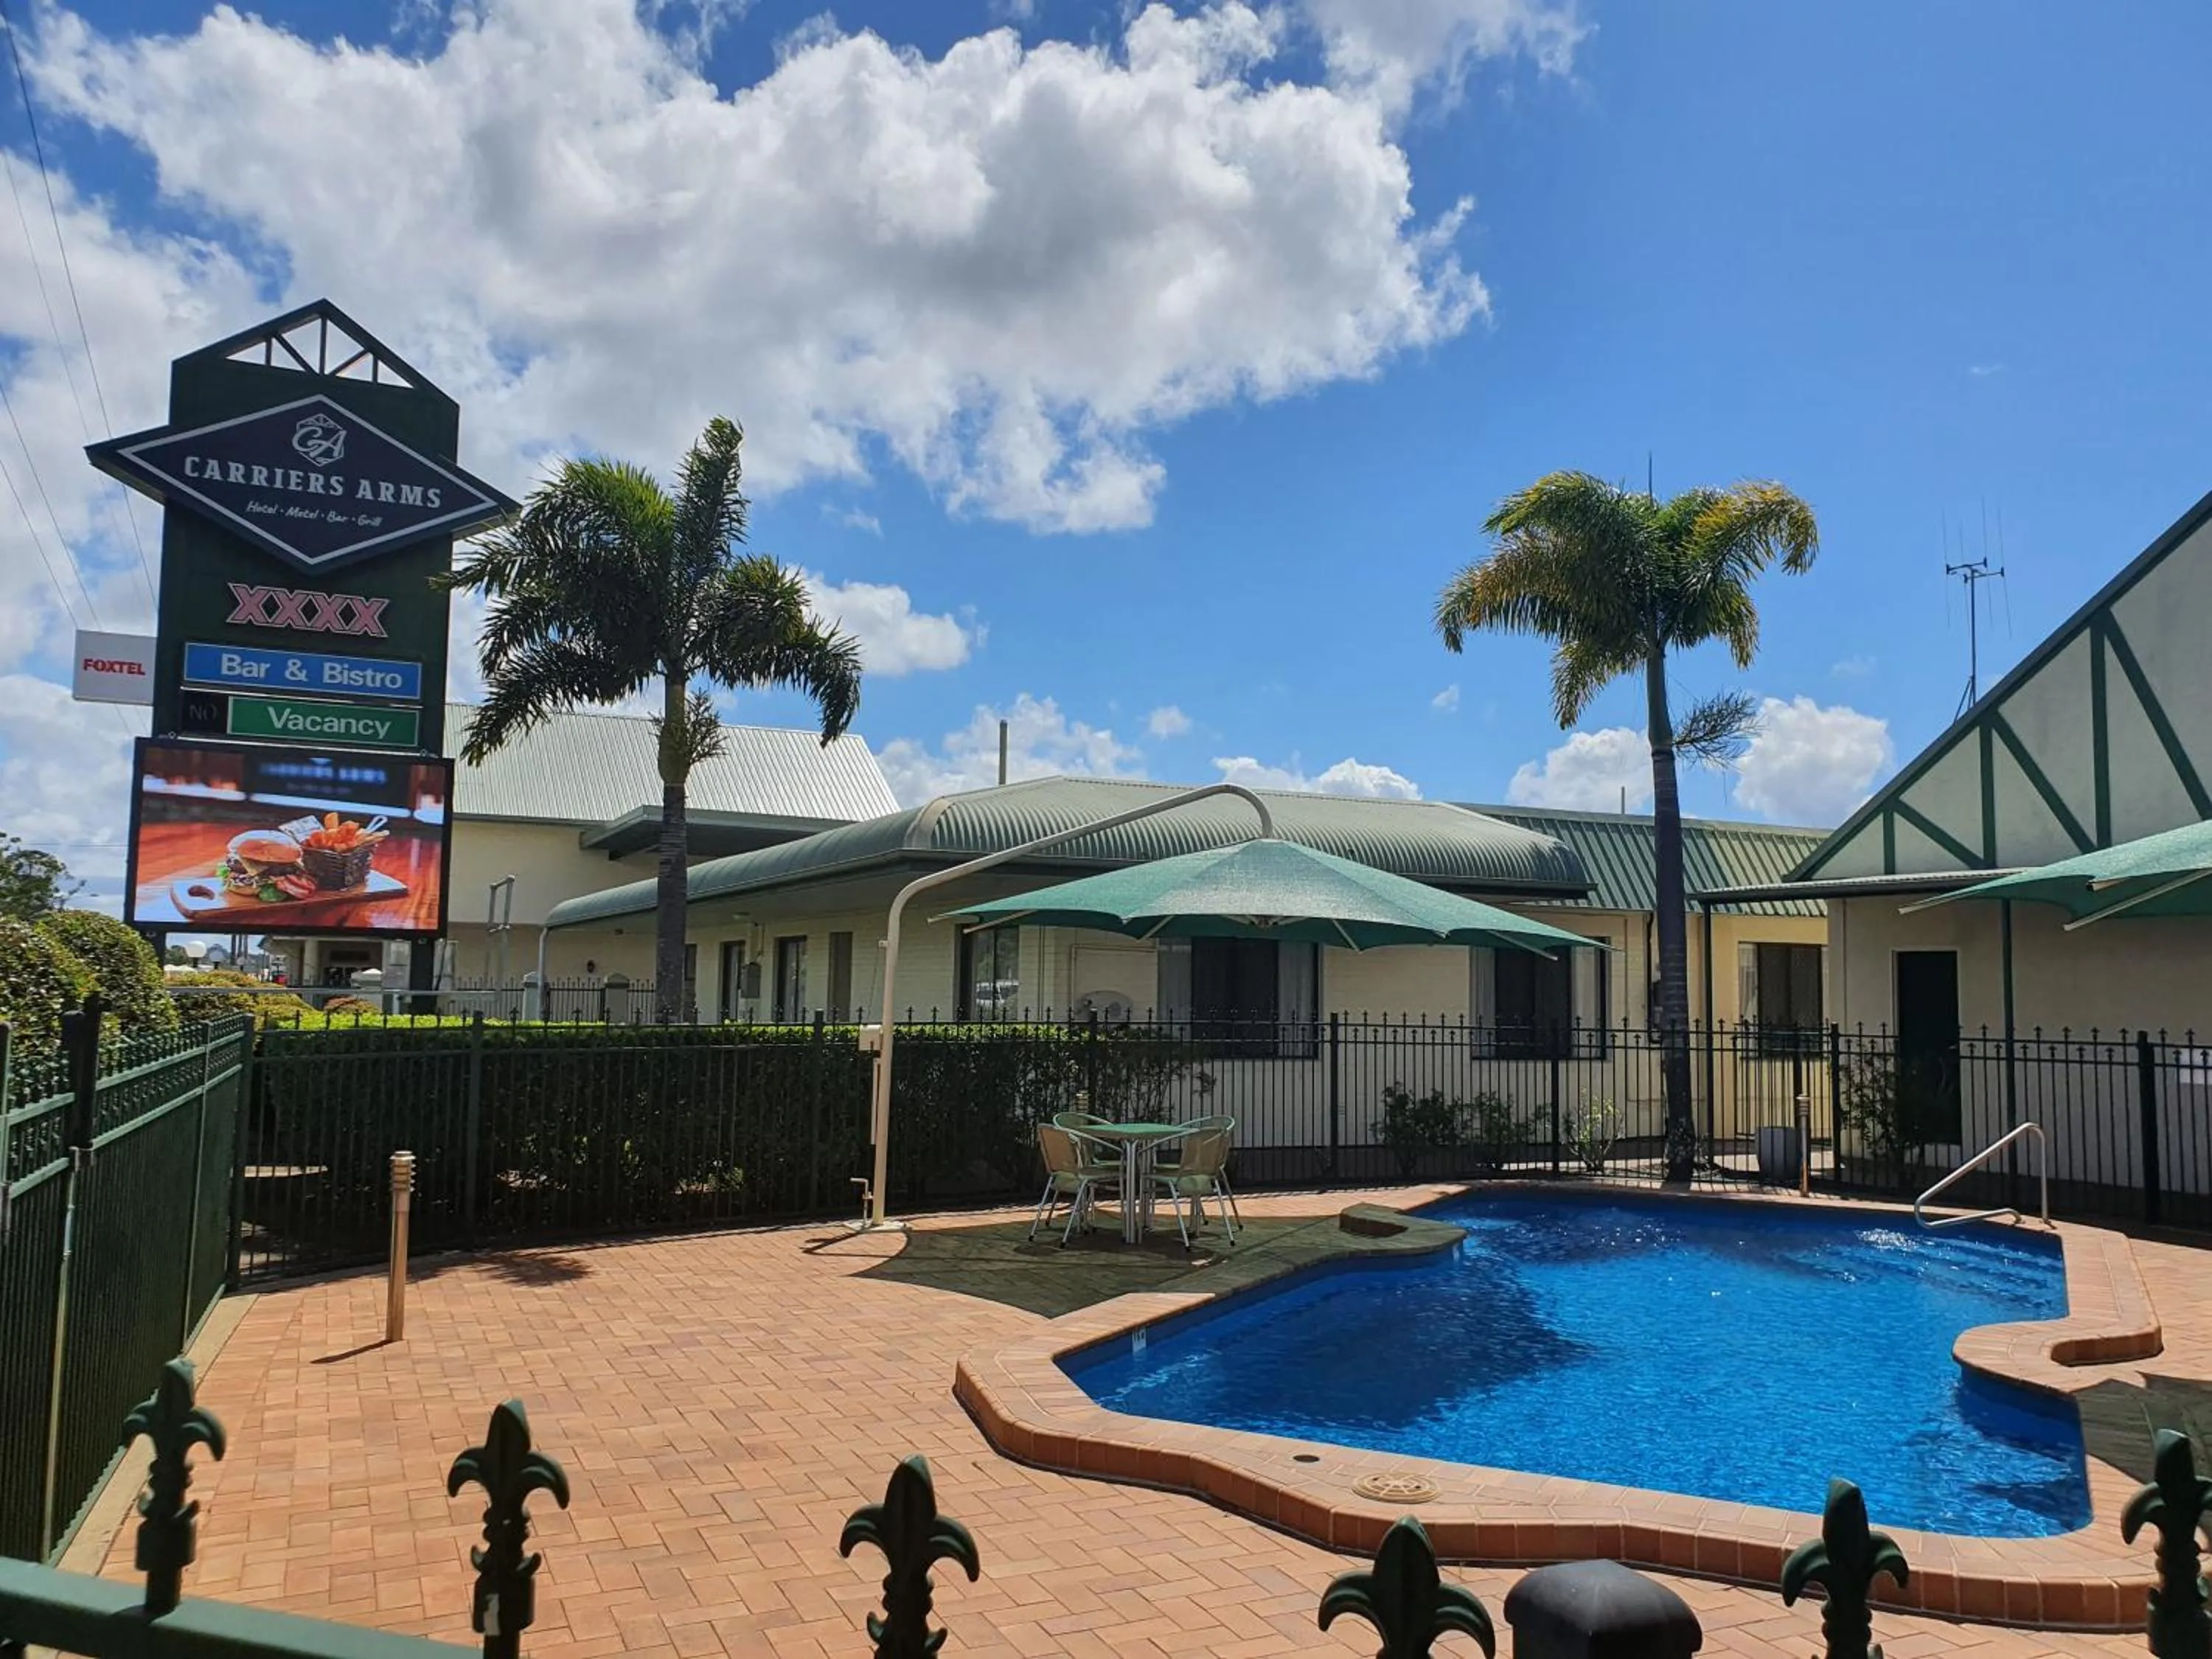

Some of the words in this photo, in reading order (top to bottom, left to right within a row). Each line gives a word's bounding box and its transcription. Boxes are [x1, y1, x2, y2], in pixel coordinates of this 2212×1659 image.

[184, 456, 344, 496] CARRIERS
[355, 479, 442, 509] ARMS
[246, 501, 279, 515] Hotel
[326, 511, 349, 524] Bar
[226, 582, 390, 638] XXXX
[83, 658, 146, 676] FOXTEL
[220, 653, 271, 679] Bar
[285, 658, 308, 682] &
[322, 662, 403, 689] Bistro
[189, 704, 218, 721] NO
[267, 706, 392, 740] Vacancy
